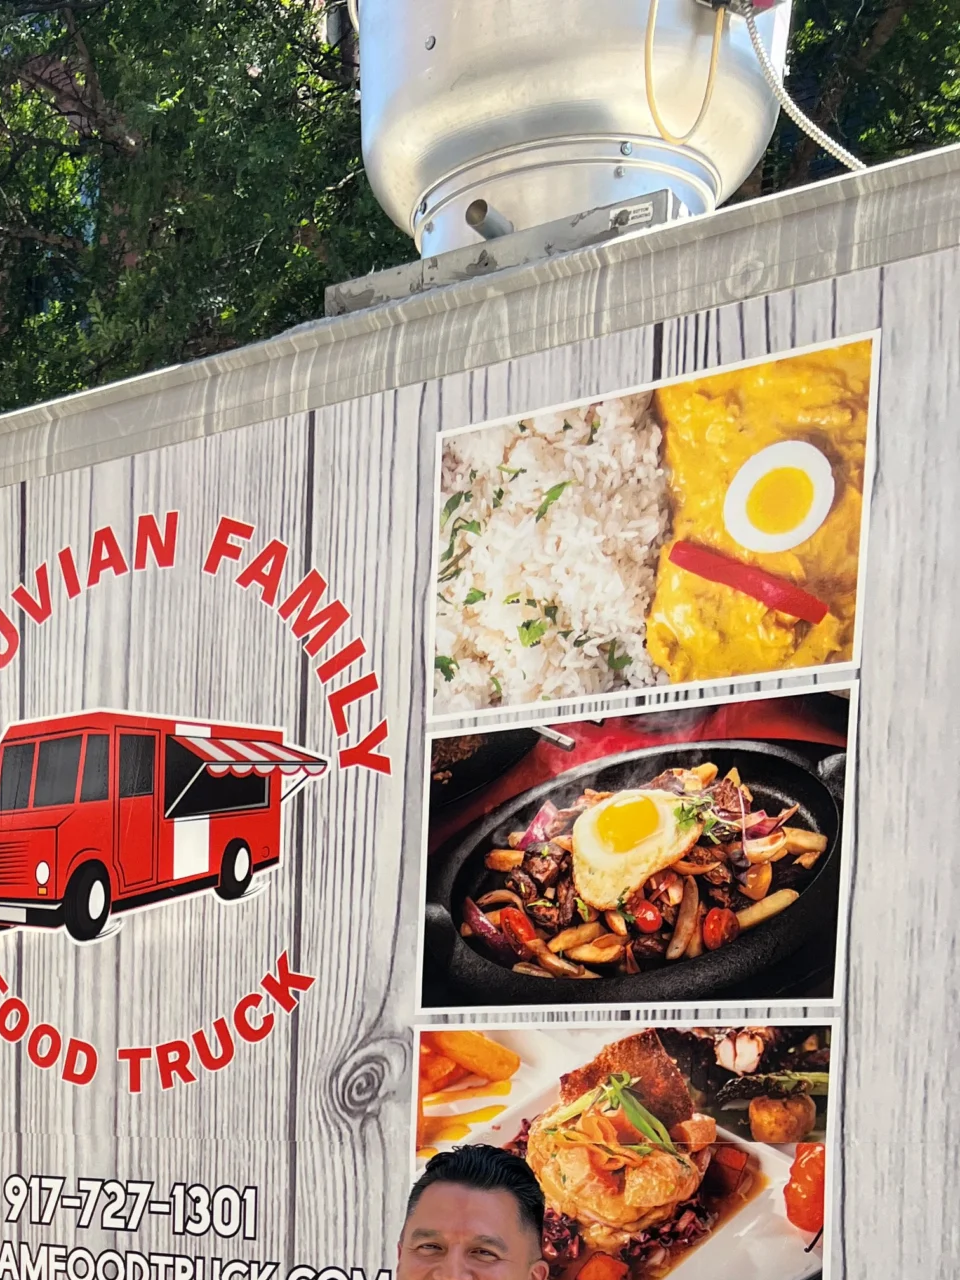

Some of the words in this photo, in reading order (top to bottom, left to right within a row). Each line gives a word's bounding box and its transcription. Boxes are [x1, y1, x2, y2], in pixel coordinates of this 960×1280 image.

[203, 516, 392, 776] FAMILY
[117, 950, 316, 1094] TRUCK
[3, 1174, 258, 1240] 917-727-1301
